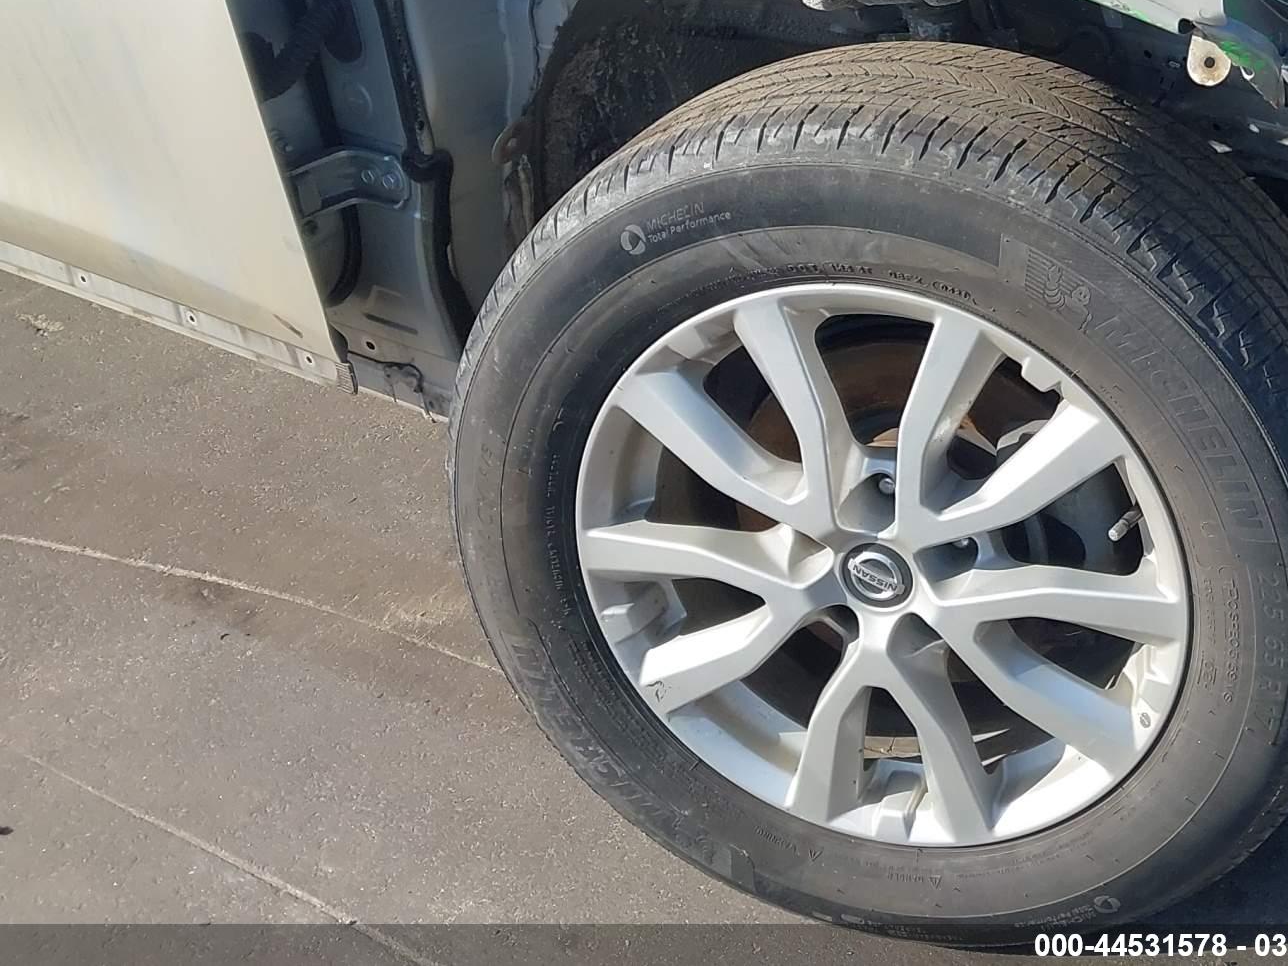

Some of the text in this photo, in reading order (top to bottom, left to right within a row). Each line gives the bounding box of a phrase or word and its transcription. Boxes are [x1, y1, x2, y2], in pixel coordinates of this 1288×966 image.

[646, 202, 704, 231] MICHELIN
[648, 211, 732, 243] Total Performance
[1095, 315, 1265, 529] MICHELIN
[853, 565, 897, 592] NISSAN
